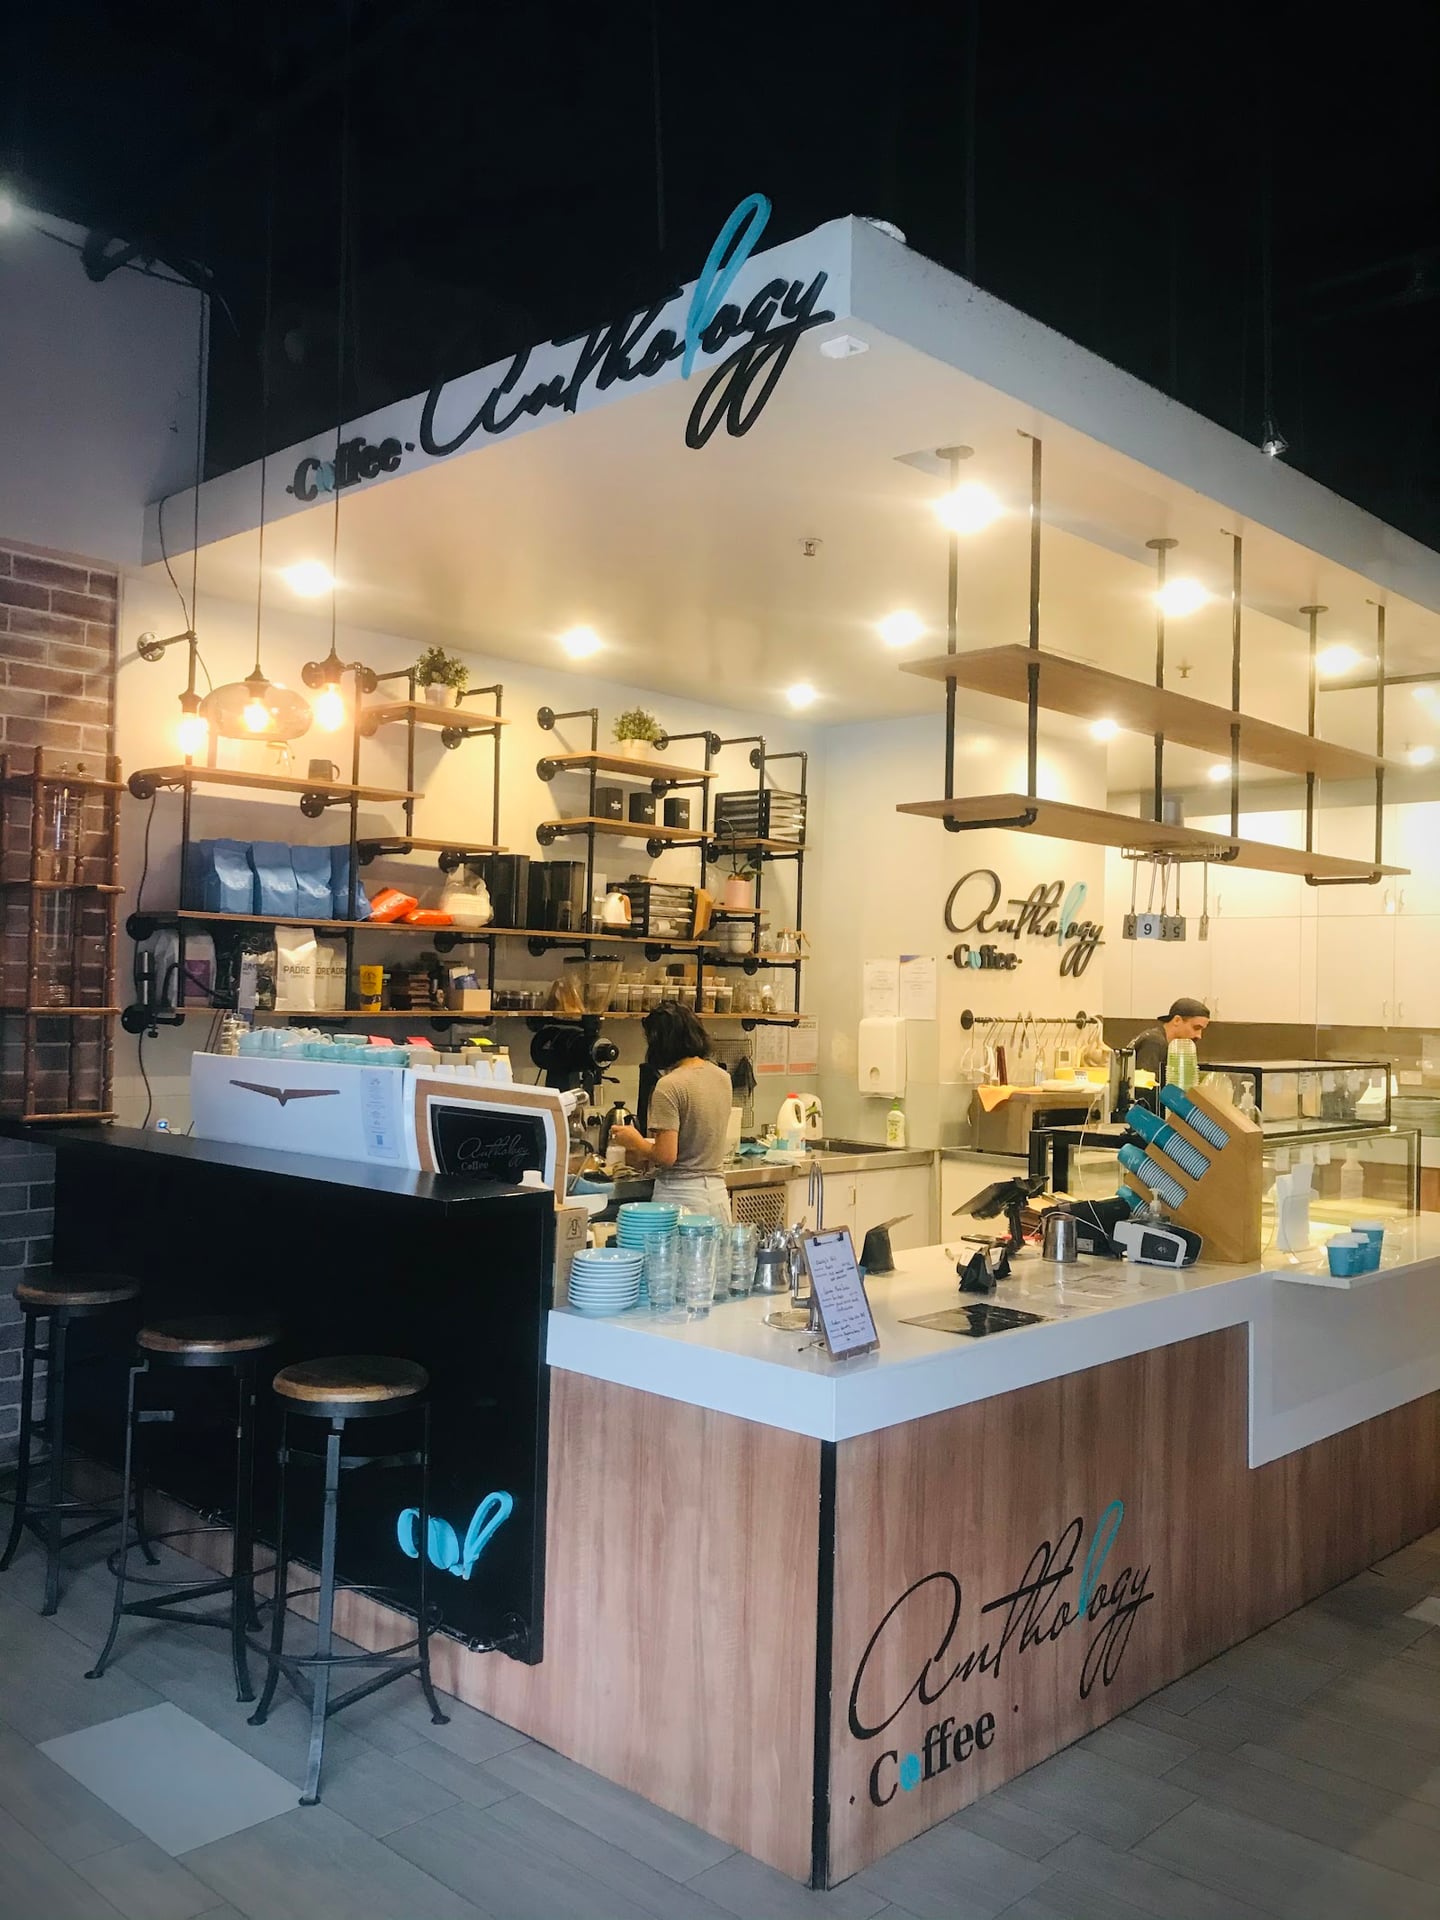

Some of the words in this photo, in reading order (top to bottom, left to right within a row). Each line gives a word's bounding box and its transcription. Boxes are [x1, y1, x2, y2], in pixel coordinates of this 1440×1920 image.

[294, 437, 403, 501] Coffee
[419, 193, 835, 456] Anthology
[283, 965, 311, 975] PADRE
[944, 869, 1106, 977] Anthology
[953, 944, 1017, 970] Coffee
[457, 1134, 530, 1168] Anthology
[848, 1500, 1154, 1740] Anthology
[869, 1712, 996, 1807] Coffee
